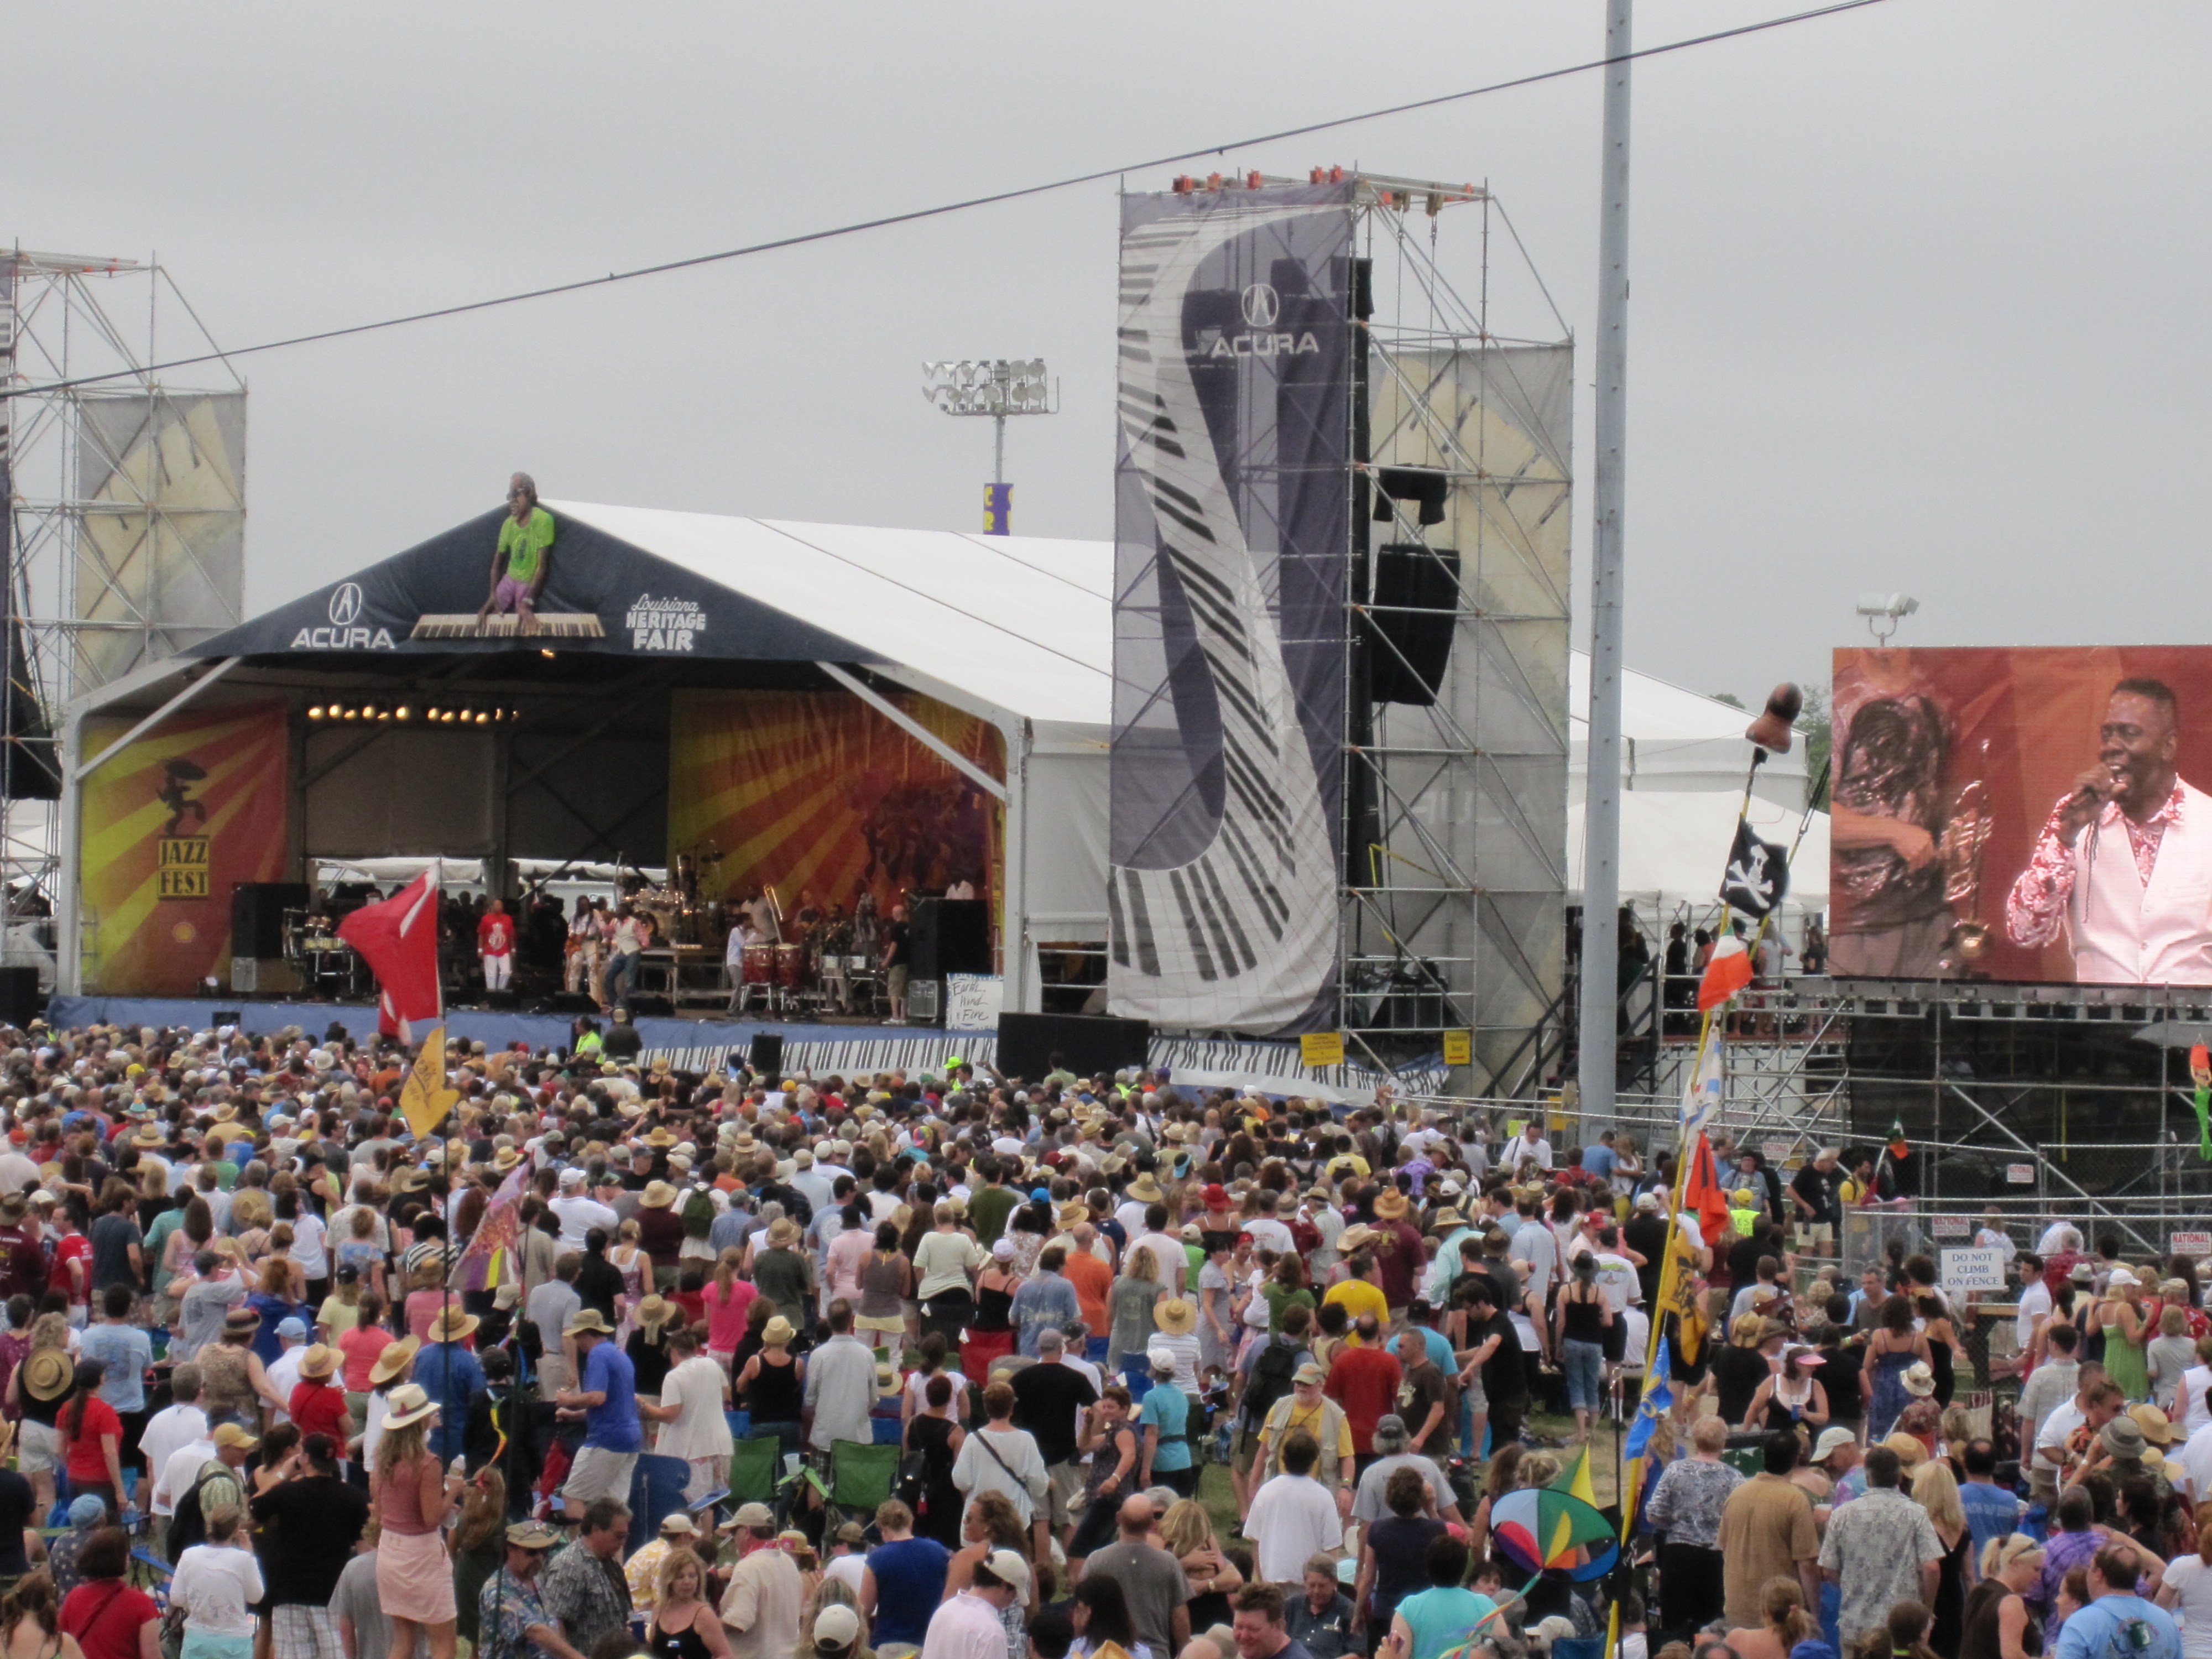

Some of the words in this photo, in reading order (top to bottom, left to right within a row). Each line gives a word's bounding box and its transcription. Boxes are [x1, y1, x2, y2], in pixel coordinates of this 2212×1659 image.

[1211, 332, 1319, 358] ACURA
[631, 593, 699, 612] Louisiana
[626, 611, 706, 630] HERITAGE
[290, 628, 395, 648] ACURA
[633, 629, 693, 651] FAIR
[159, 842, 207, 867] JAZZ
[160, 872, 208, 894] FEST
[2172, 1233, 2210, 1243] NATIONAL
[1972, 1253, 1992, 1261] NOT
[1948, 1277, 1963, 1286] ON
[1966, 1276, 1999, 1285] FENCE
